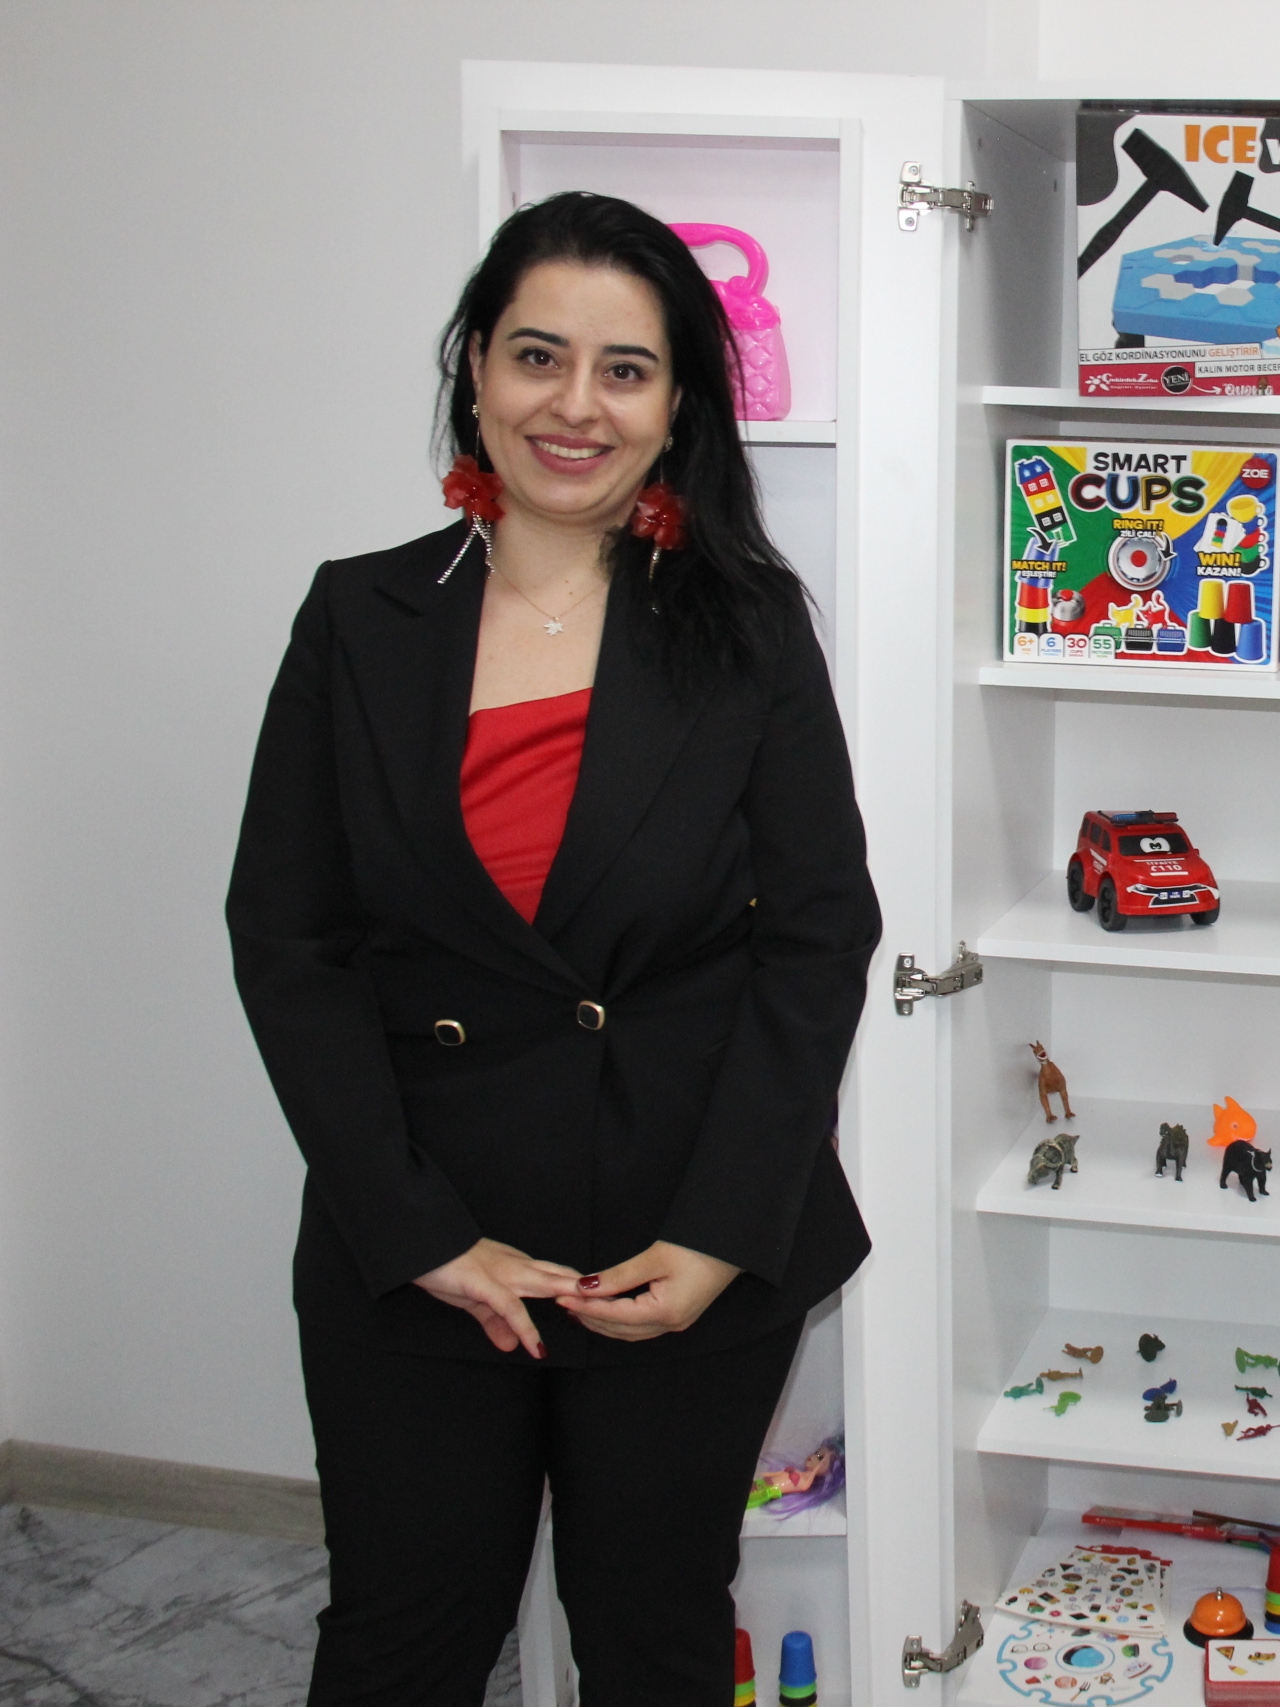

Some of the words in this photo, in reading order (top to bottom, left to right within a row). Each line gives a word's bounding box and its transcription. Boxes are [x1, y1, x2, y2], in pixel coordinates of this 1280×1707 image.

[1184, 124, 1257, 164] ICE
[1080, 353, 1090, 362] EL
[1092, 352, 1113, 362] GÖZ
[1115, 348, 1206, 361] KORDİNASYONUNU
[1208, 346, 1259, 358] GELİŞTİRİR
[1197, 365, 1223, 374] KALIN
[1225, 364, 1255, 373] MOTOR
[1163, 371, 1189, 384] YENİ
[1093, 451, 1187, 474] SMART
[1242, 469, 1270, 479] ZOE
[1070, 473, 1206, 513] CUPS
[1113, 519, 1145, 530] RING
[1146, 519, 1165, 531] IT!
[1119, 529, 1136, 538] ZİLİ
[1137, 530, 1157, 539] ÇAL!
[1199, 551, 1241, 568] WIN!
[1012, 560, 1050, 571] MATCH
[1052, 561, 1067, 571] IT!
[1197, 566, 1241, 577] KAZAN!
[1017, 636, 1034, 647] 6+
[1046, 637, 1056, 647] 6
[1067, 637, 1087, 648] 30
[1093, 638, 1112, 649] 55
